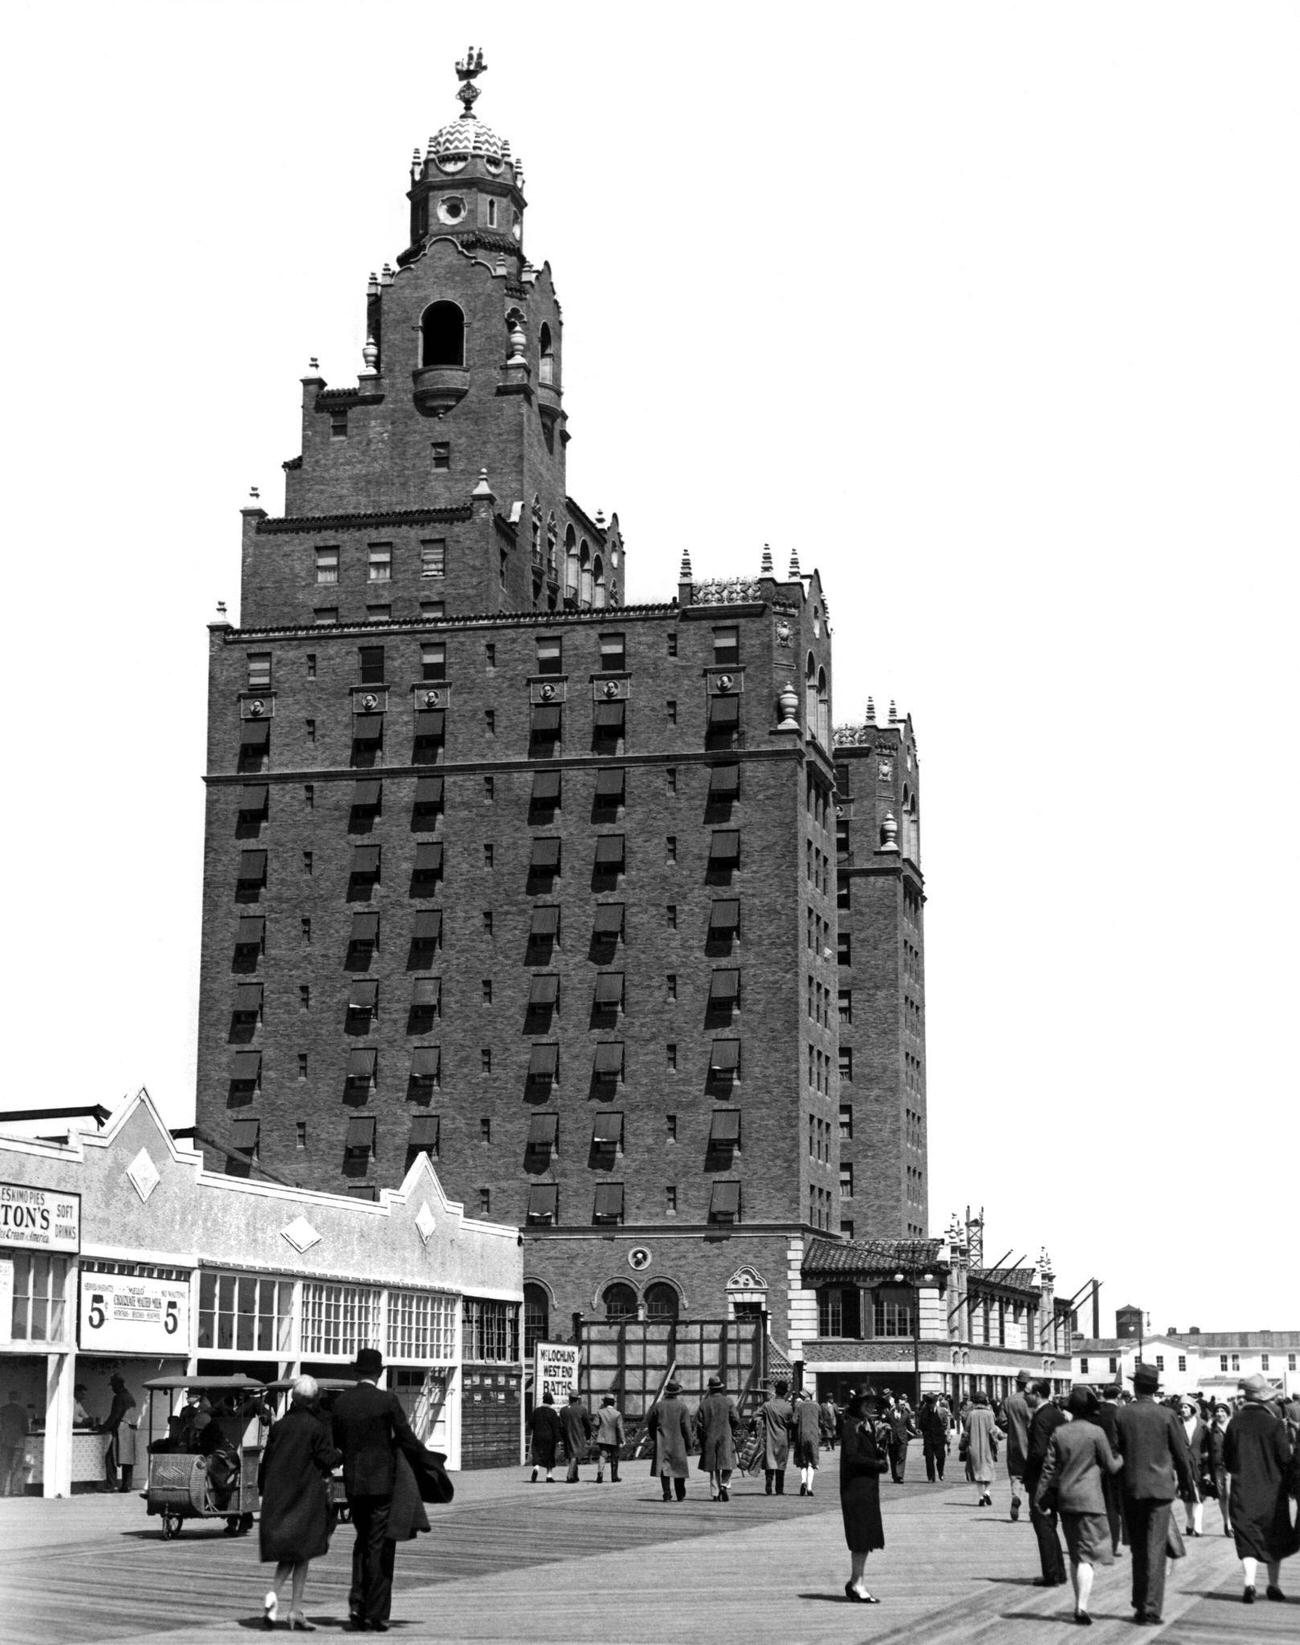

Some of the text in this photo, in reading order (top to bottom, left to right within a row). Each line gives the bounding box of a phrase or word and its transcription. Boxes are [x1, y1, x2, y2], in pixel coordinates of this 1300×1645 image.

[2, 1187, 45, 1206] ESKIMO PIES
[0, 1204, 50, 1230] TON'S
[57, 1203, 73, 1218] SOFT
[55, 1224, 76, 1240] DRINKS
[543, 1365, 573, 1378] WEST END
[543, 1380, 573, 1396] BATHS
